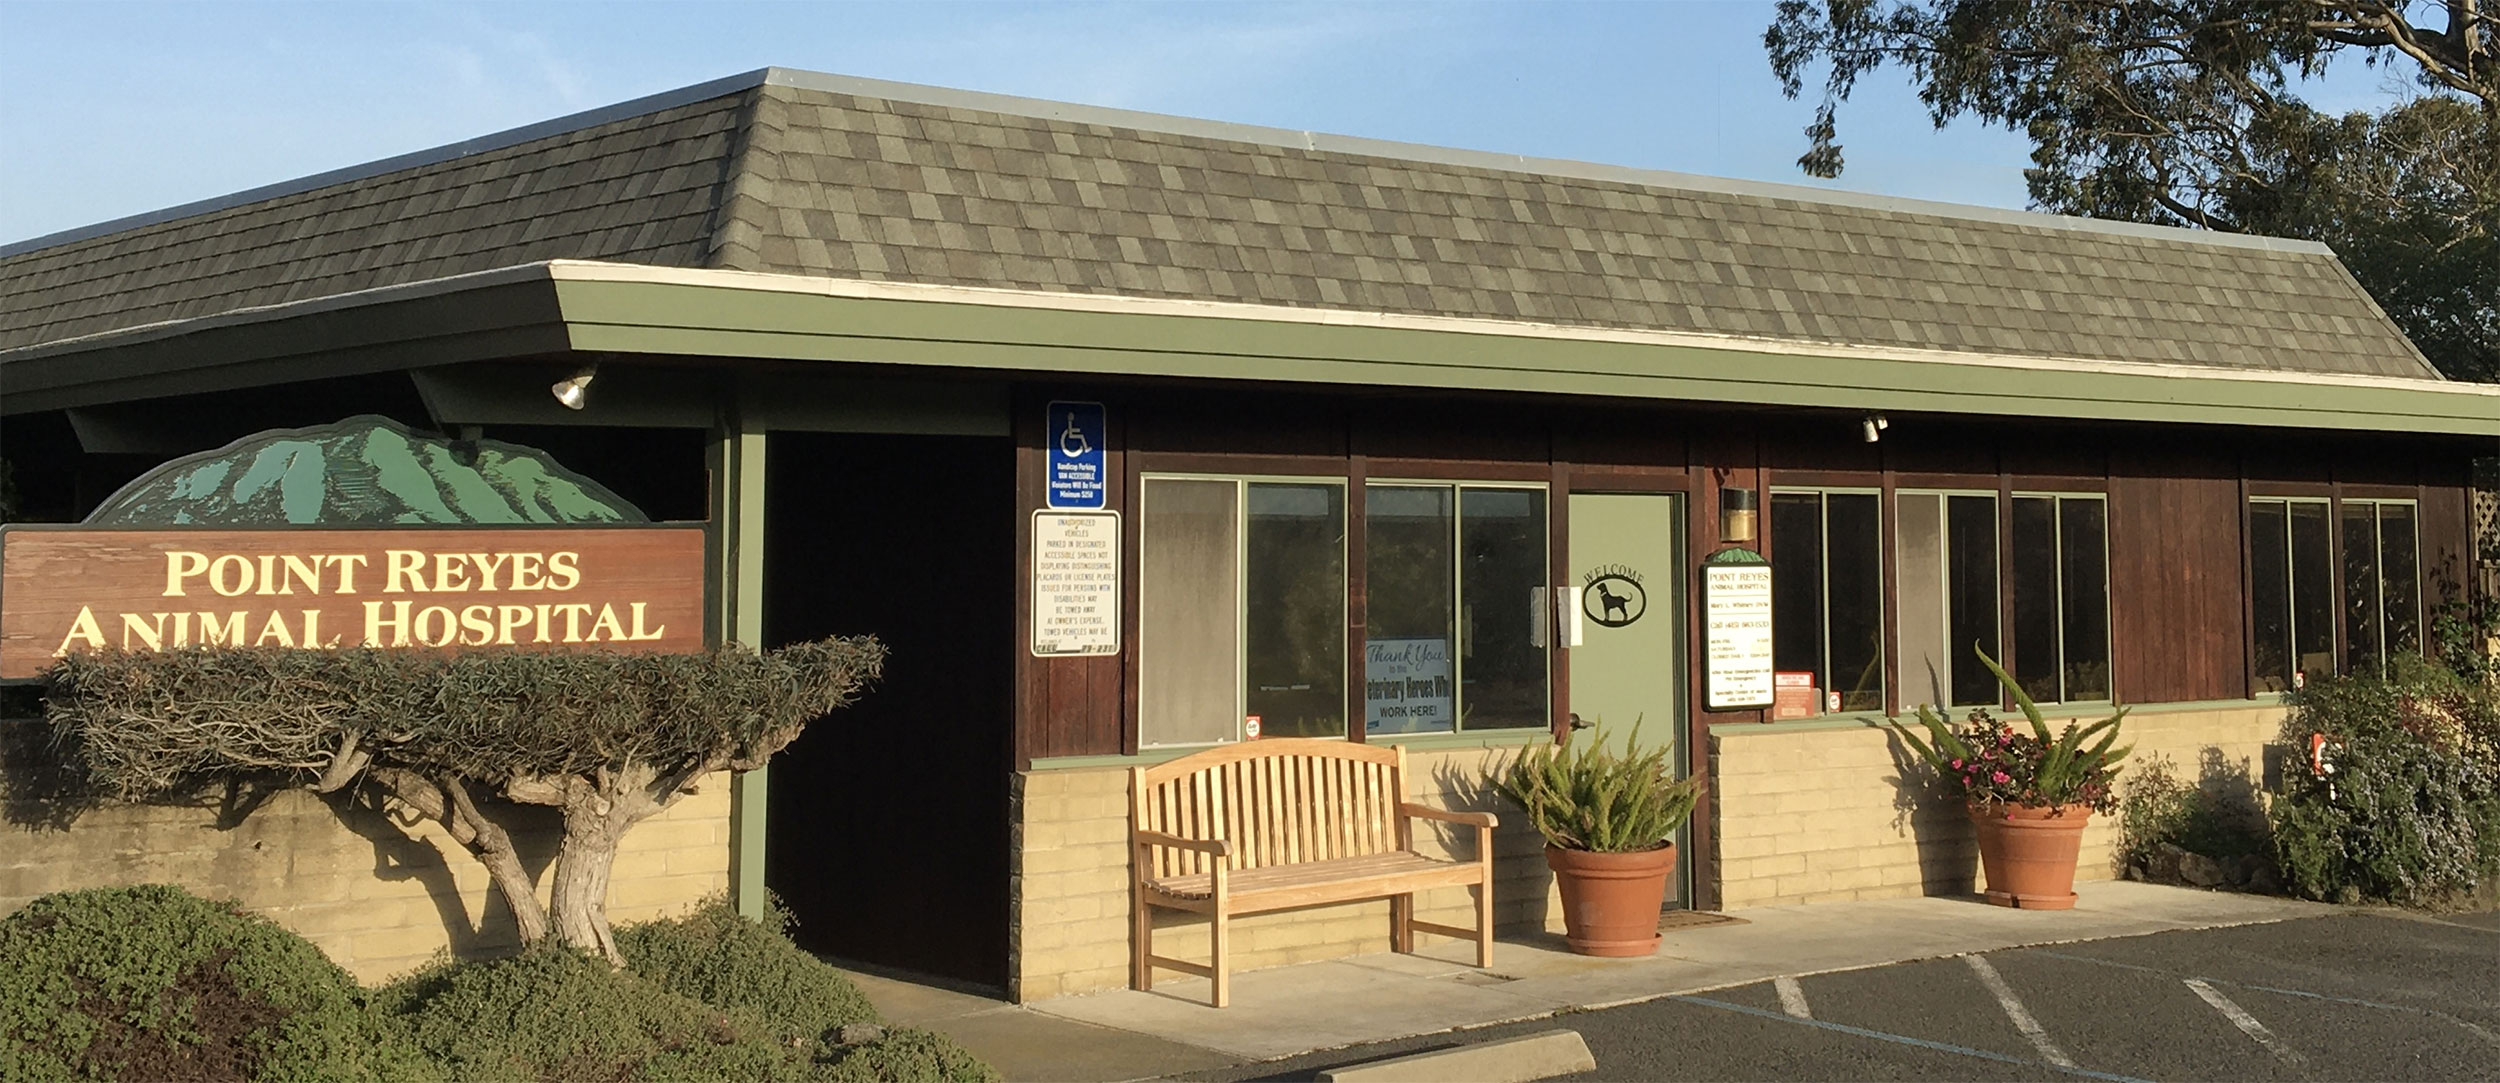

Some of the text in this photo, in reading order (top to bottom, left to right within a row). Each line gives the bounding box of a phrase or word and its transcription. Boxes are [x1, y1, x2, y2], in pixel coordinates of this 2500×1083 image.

[1040, 562, 1070, 570] DISPLAYING
[162, 549, 580, 596] POINT REYES
[1583, 563, 1645, 584] WELCOME
[1709, 572, 1769, 582] POINT REYES
[1041, 584, 1060, 592] ISSUED
[1062, 584, 1071, 592] FOR
[1074, 584, 1097, 592] PERSONS
[1065, 606, 1082, 614] TOWED
[52, 599, 665, 657] ANIMAL HOSPITAL
[1044, 628, 1060, 636] TOWED
[1063, 628, 1087, 636] VEHICLES
[1366, 644, 1444, 671] Thank You
[1368, 675, 1449, 702] eterinary Heroes Wh
[1380, 705, 1437, 717] WORK HERE!
